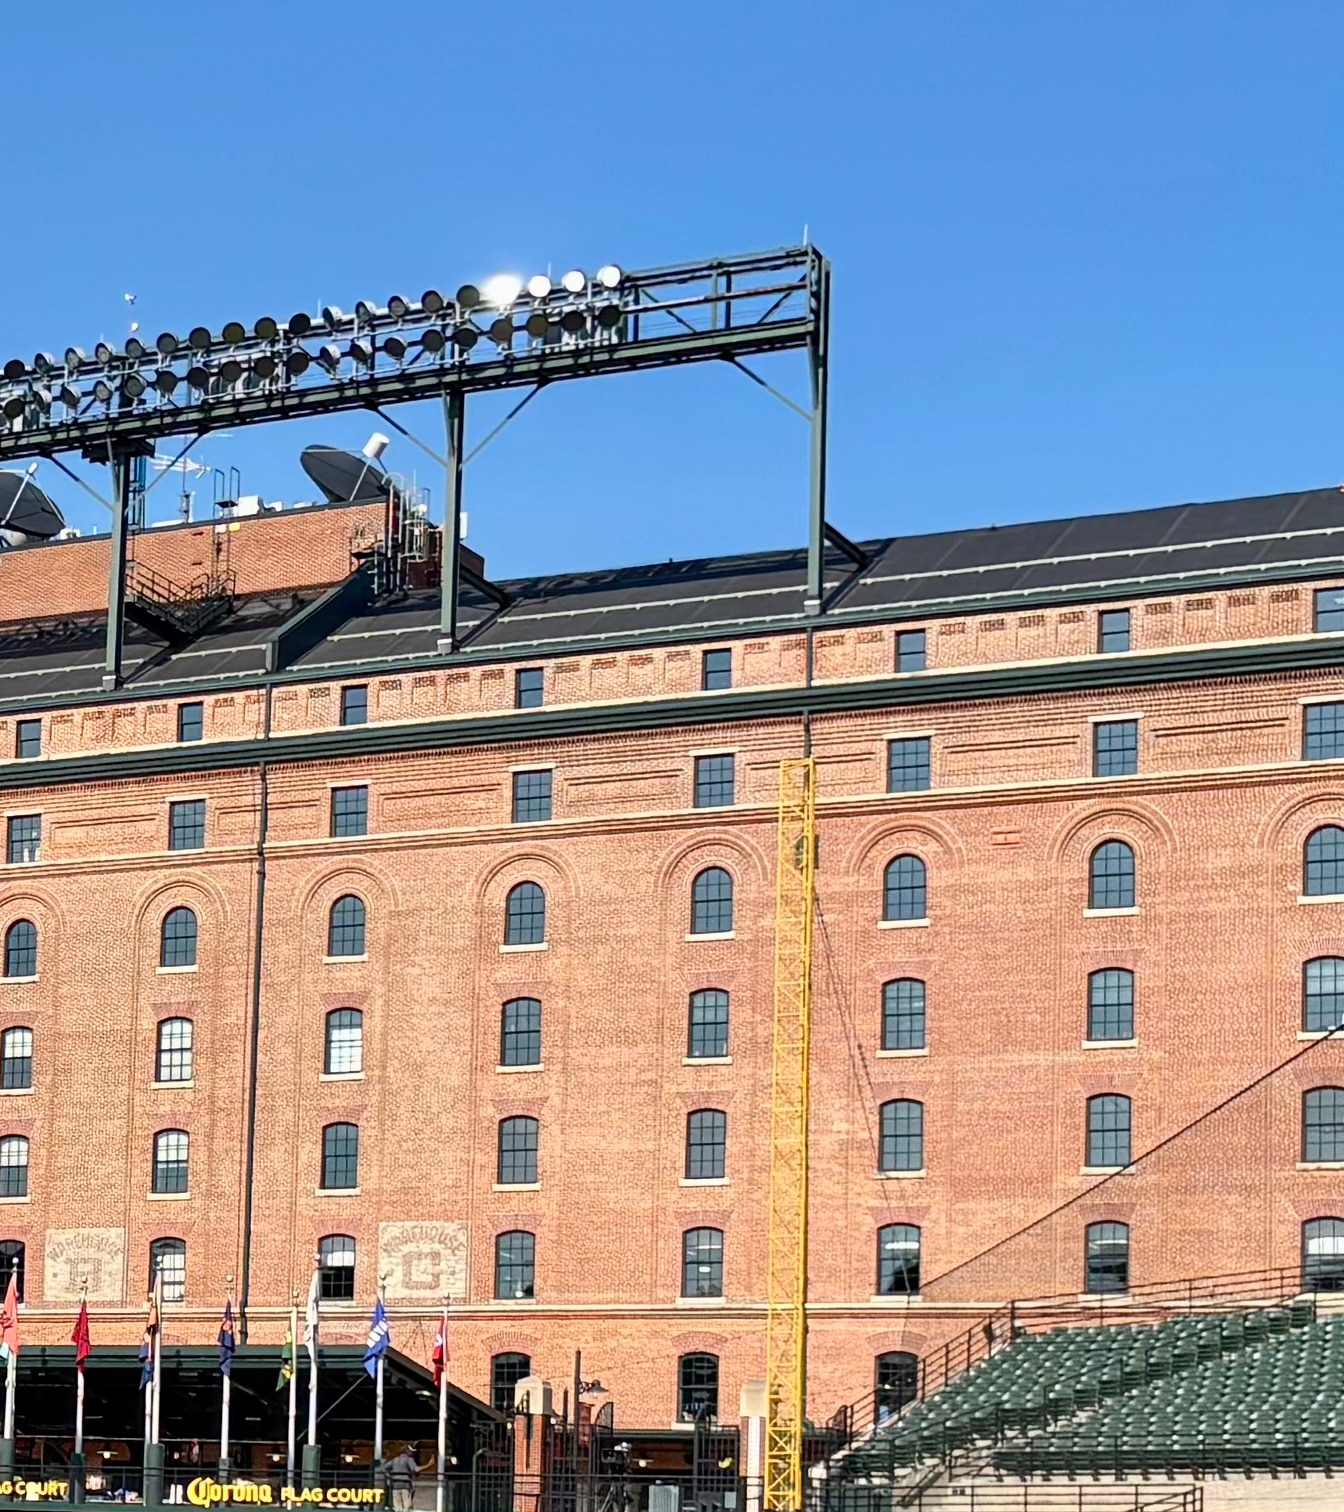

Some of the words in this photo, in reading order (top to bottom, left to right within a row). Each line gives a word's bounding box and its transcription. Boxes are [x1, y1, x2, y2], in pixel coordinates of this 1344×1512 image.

[187, 1478, 273, 1508] Corona
[281, 1488, 323, 1502] FLAG
[327, 1488, 384, 1503] COURT
